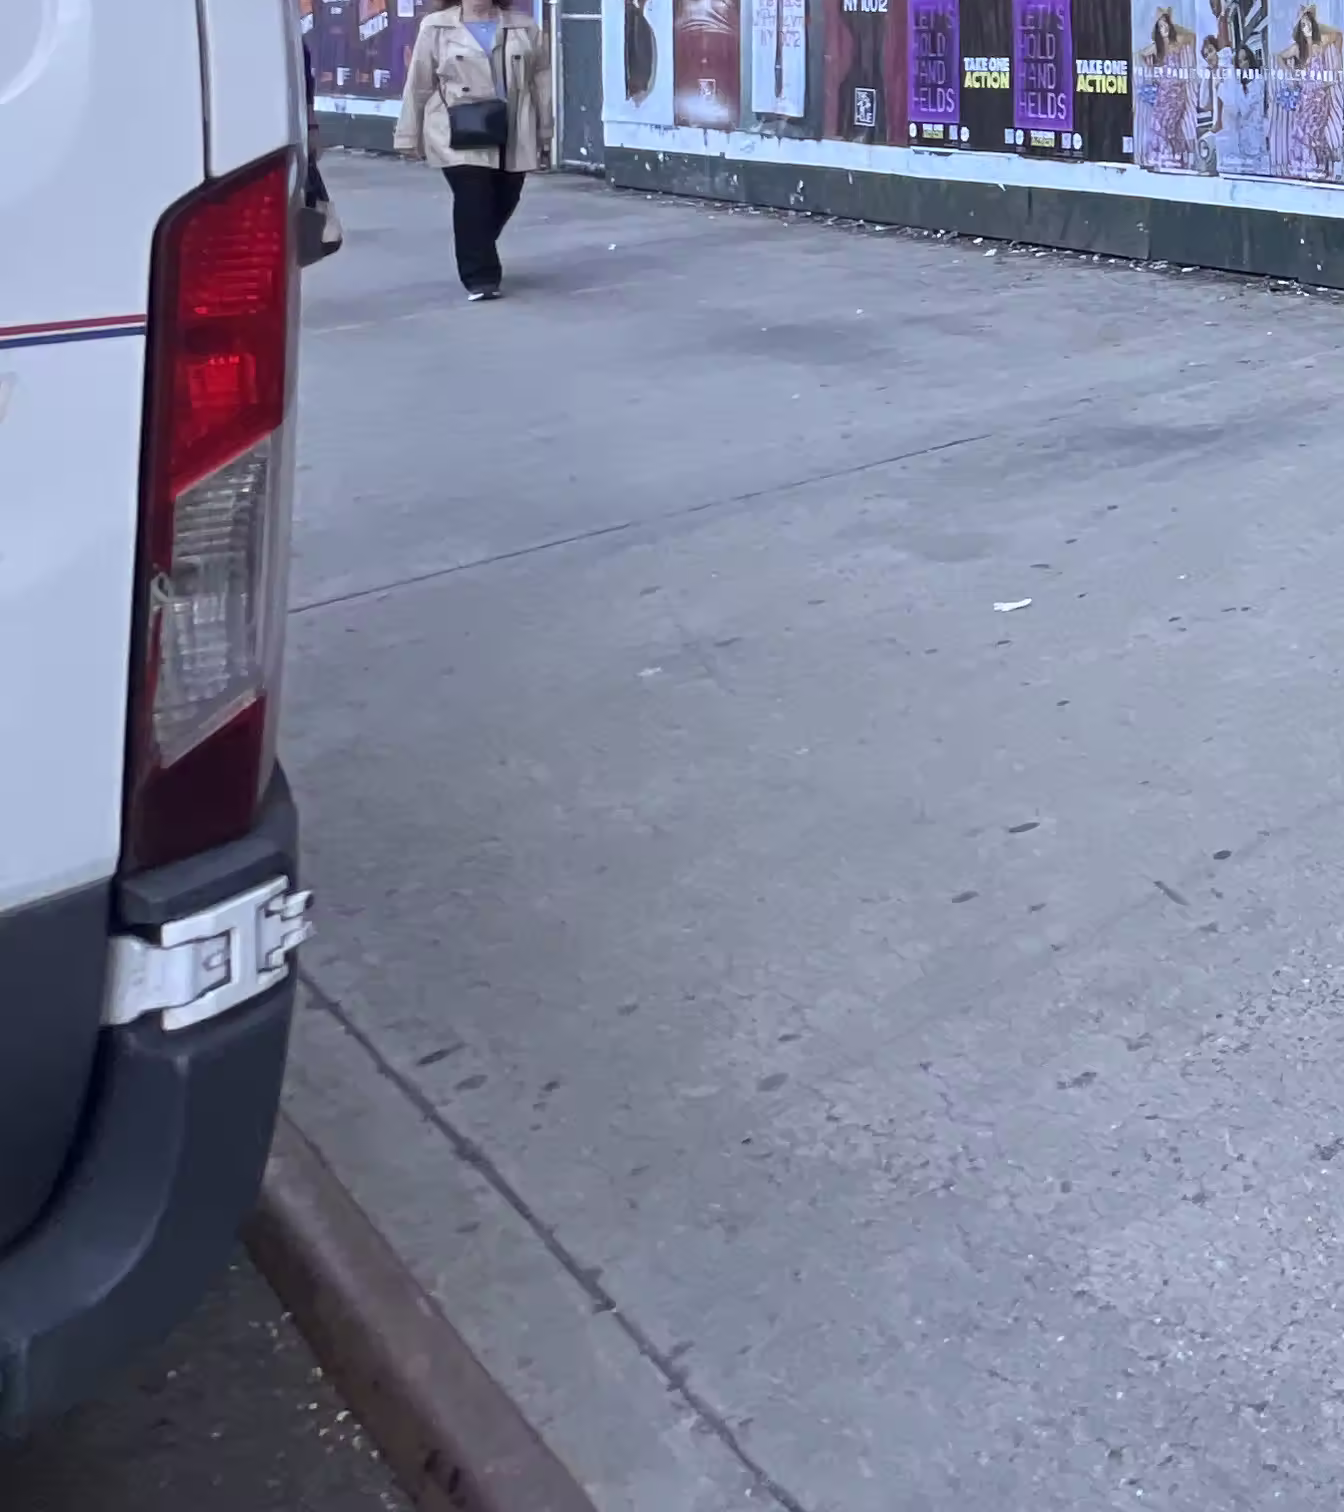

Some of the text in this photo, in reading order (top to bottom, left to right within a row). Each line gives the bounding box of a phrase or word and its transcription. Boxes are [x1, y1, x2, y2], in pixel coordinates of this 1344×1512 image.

[963, 57, 1010, 72] TAKE ONE
[1076, 59, 1128, 74] TAKE ONE
[963, 72, 1010, 89] ACTION
[1076, 75, 1128, 94] ACTION
